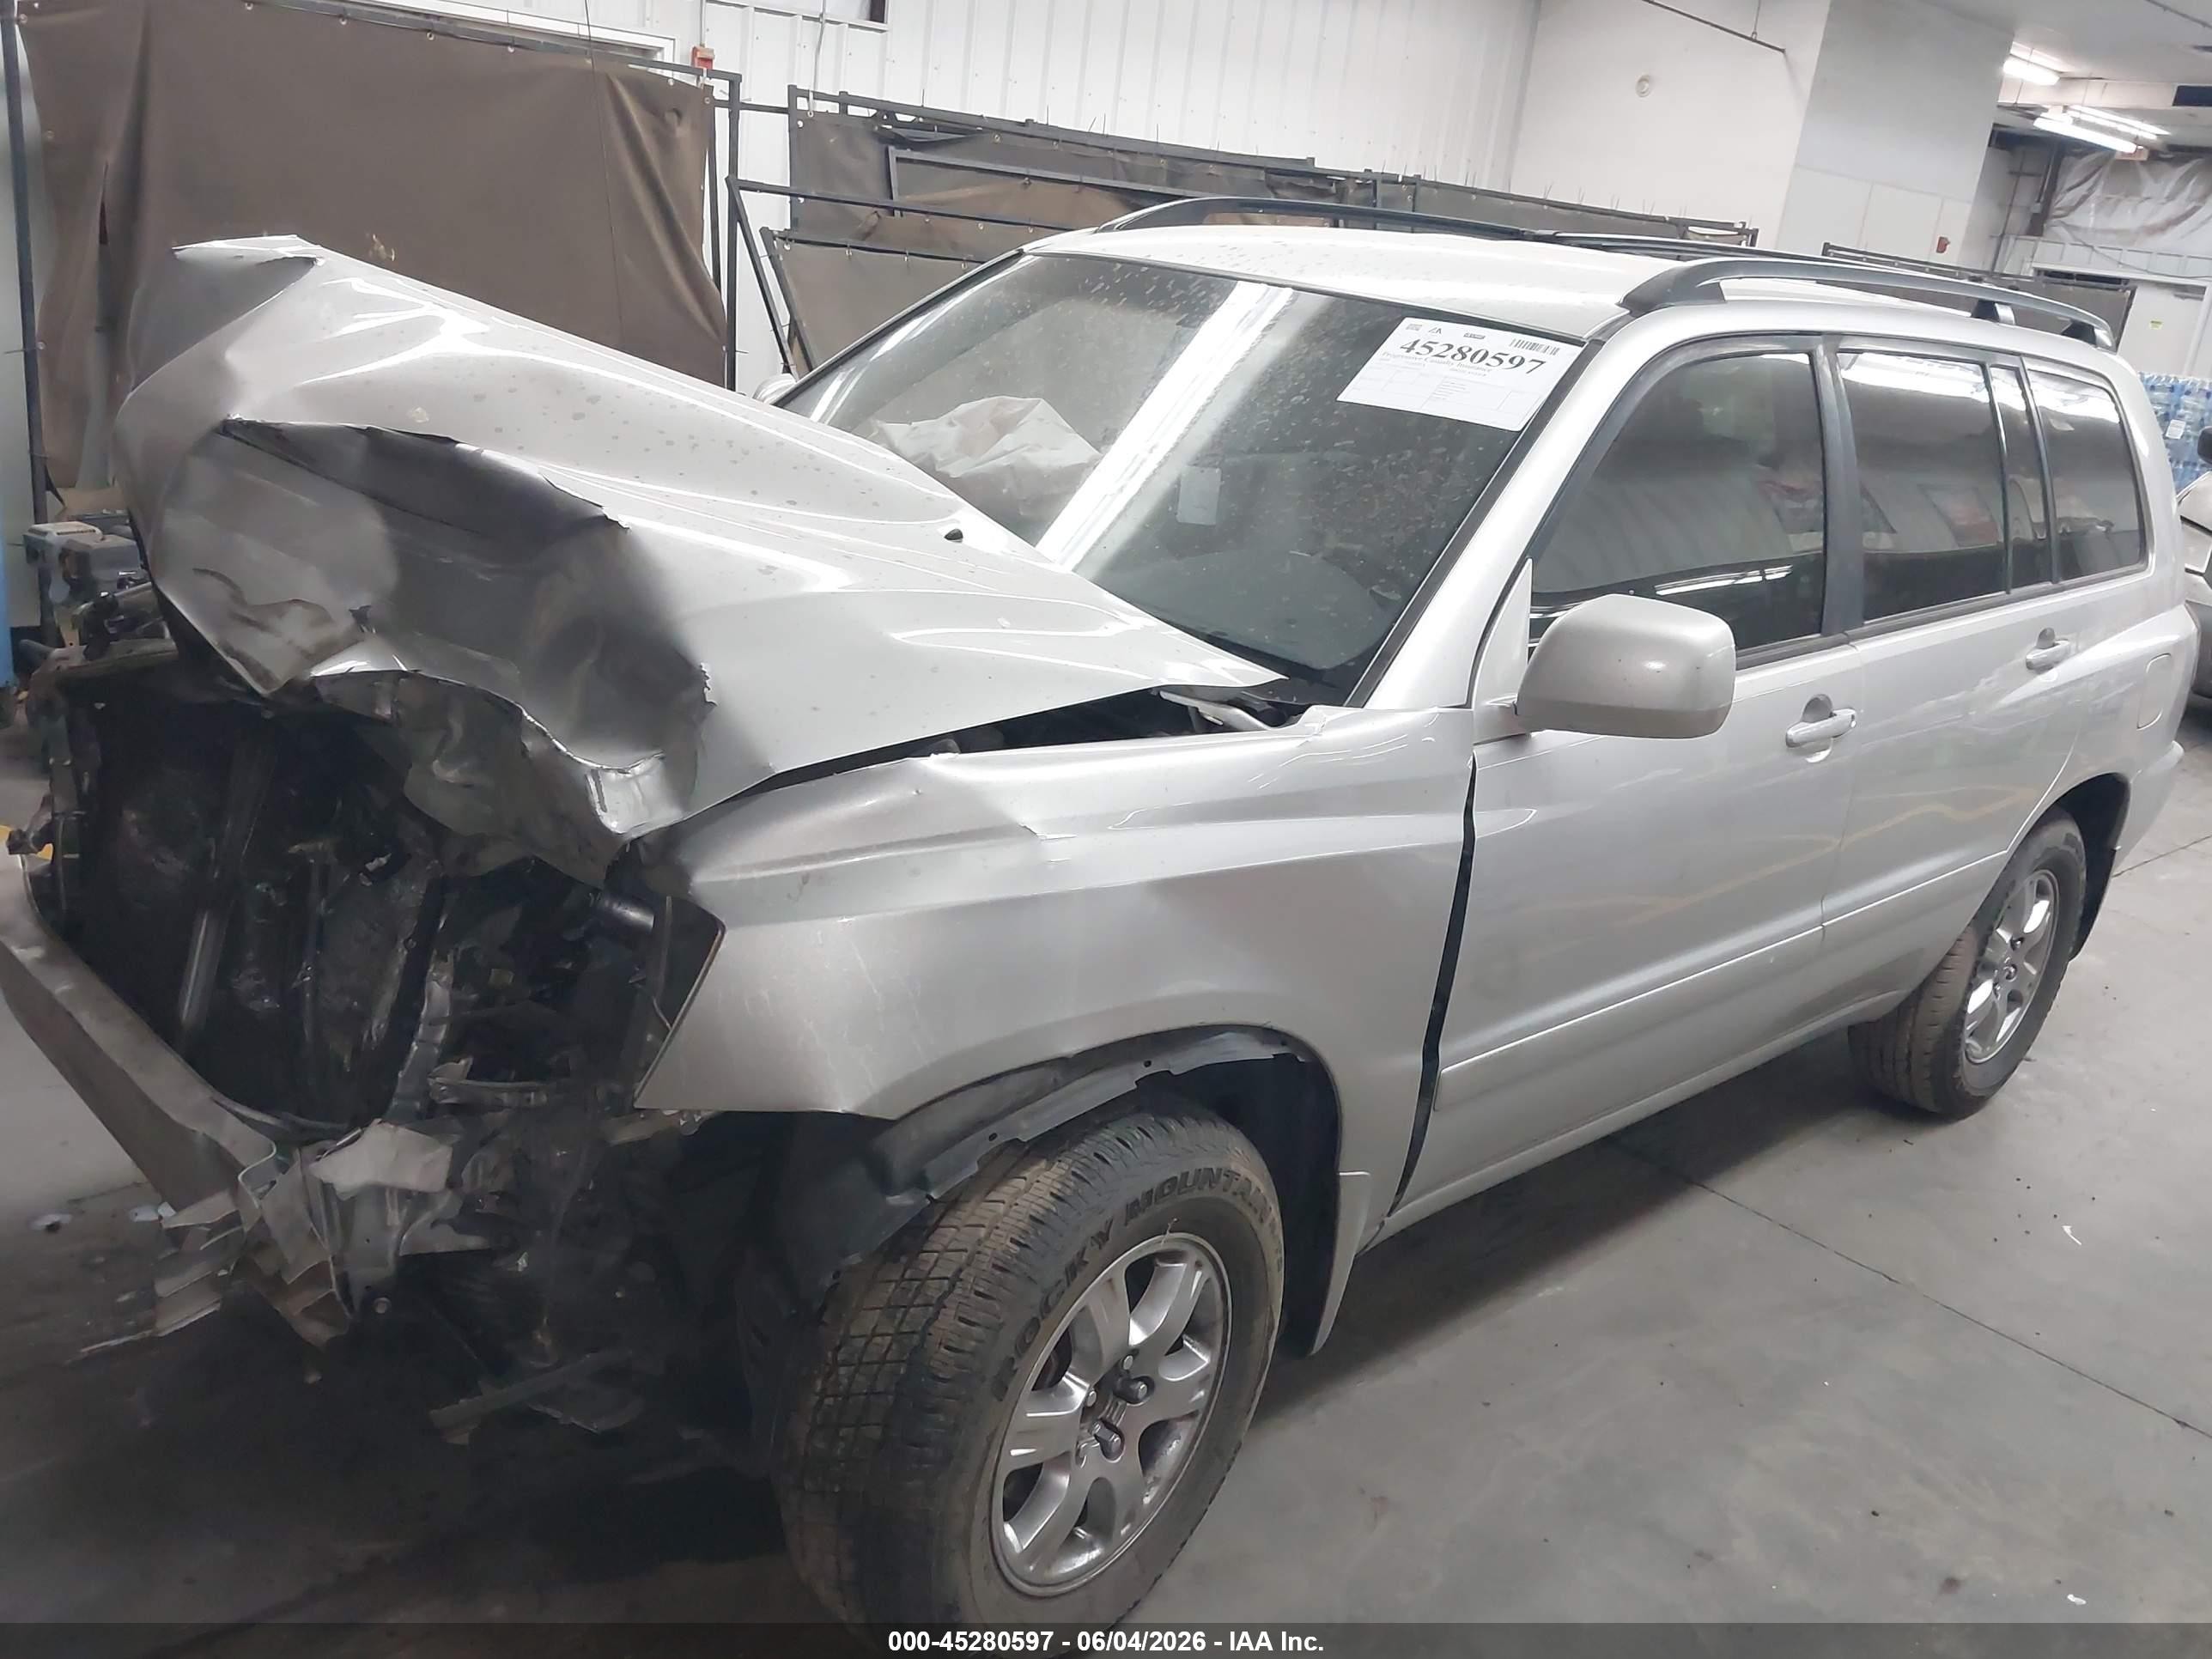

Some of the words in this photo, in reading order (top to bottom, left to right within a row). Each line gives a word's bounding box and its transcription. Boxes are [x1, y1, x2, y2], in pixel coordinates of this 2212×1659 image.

[1399, 338, 1547, 374] 45280597
[991, 1218, 1114, 1401] ROCKY
[1125, 1167, 1273, 1226] MOUNTAIN
